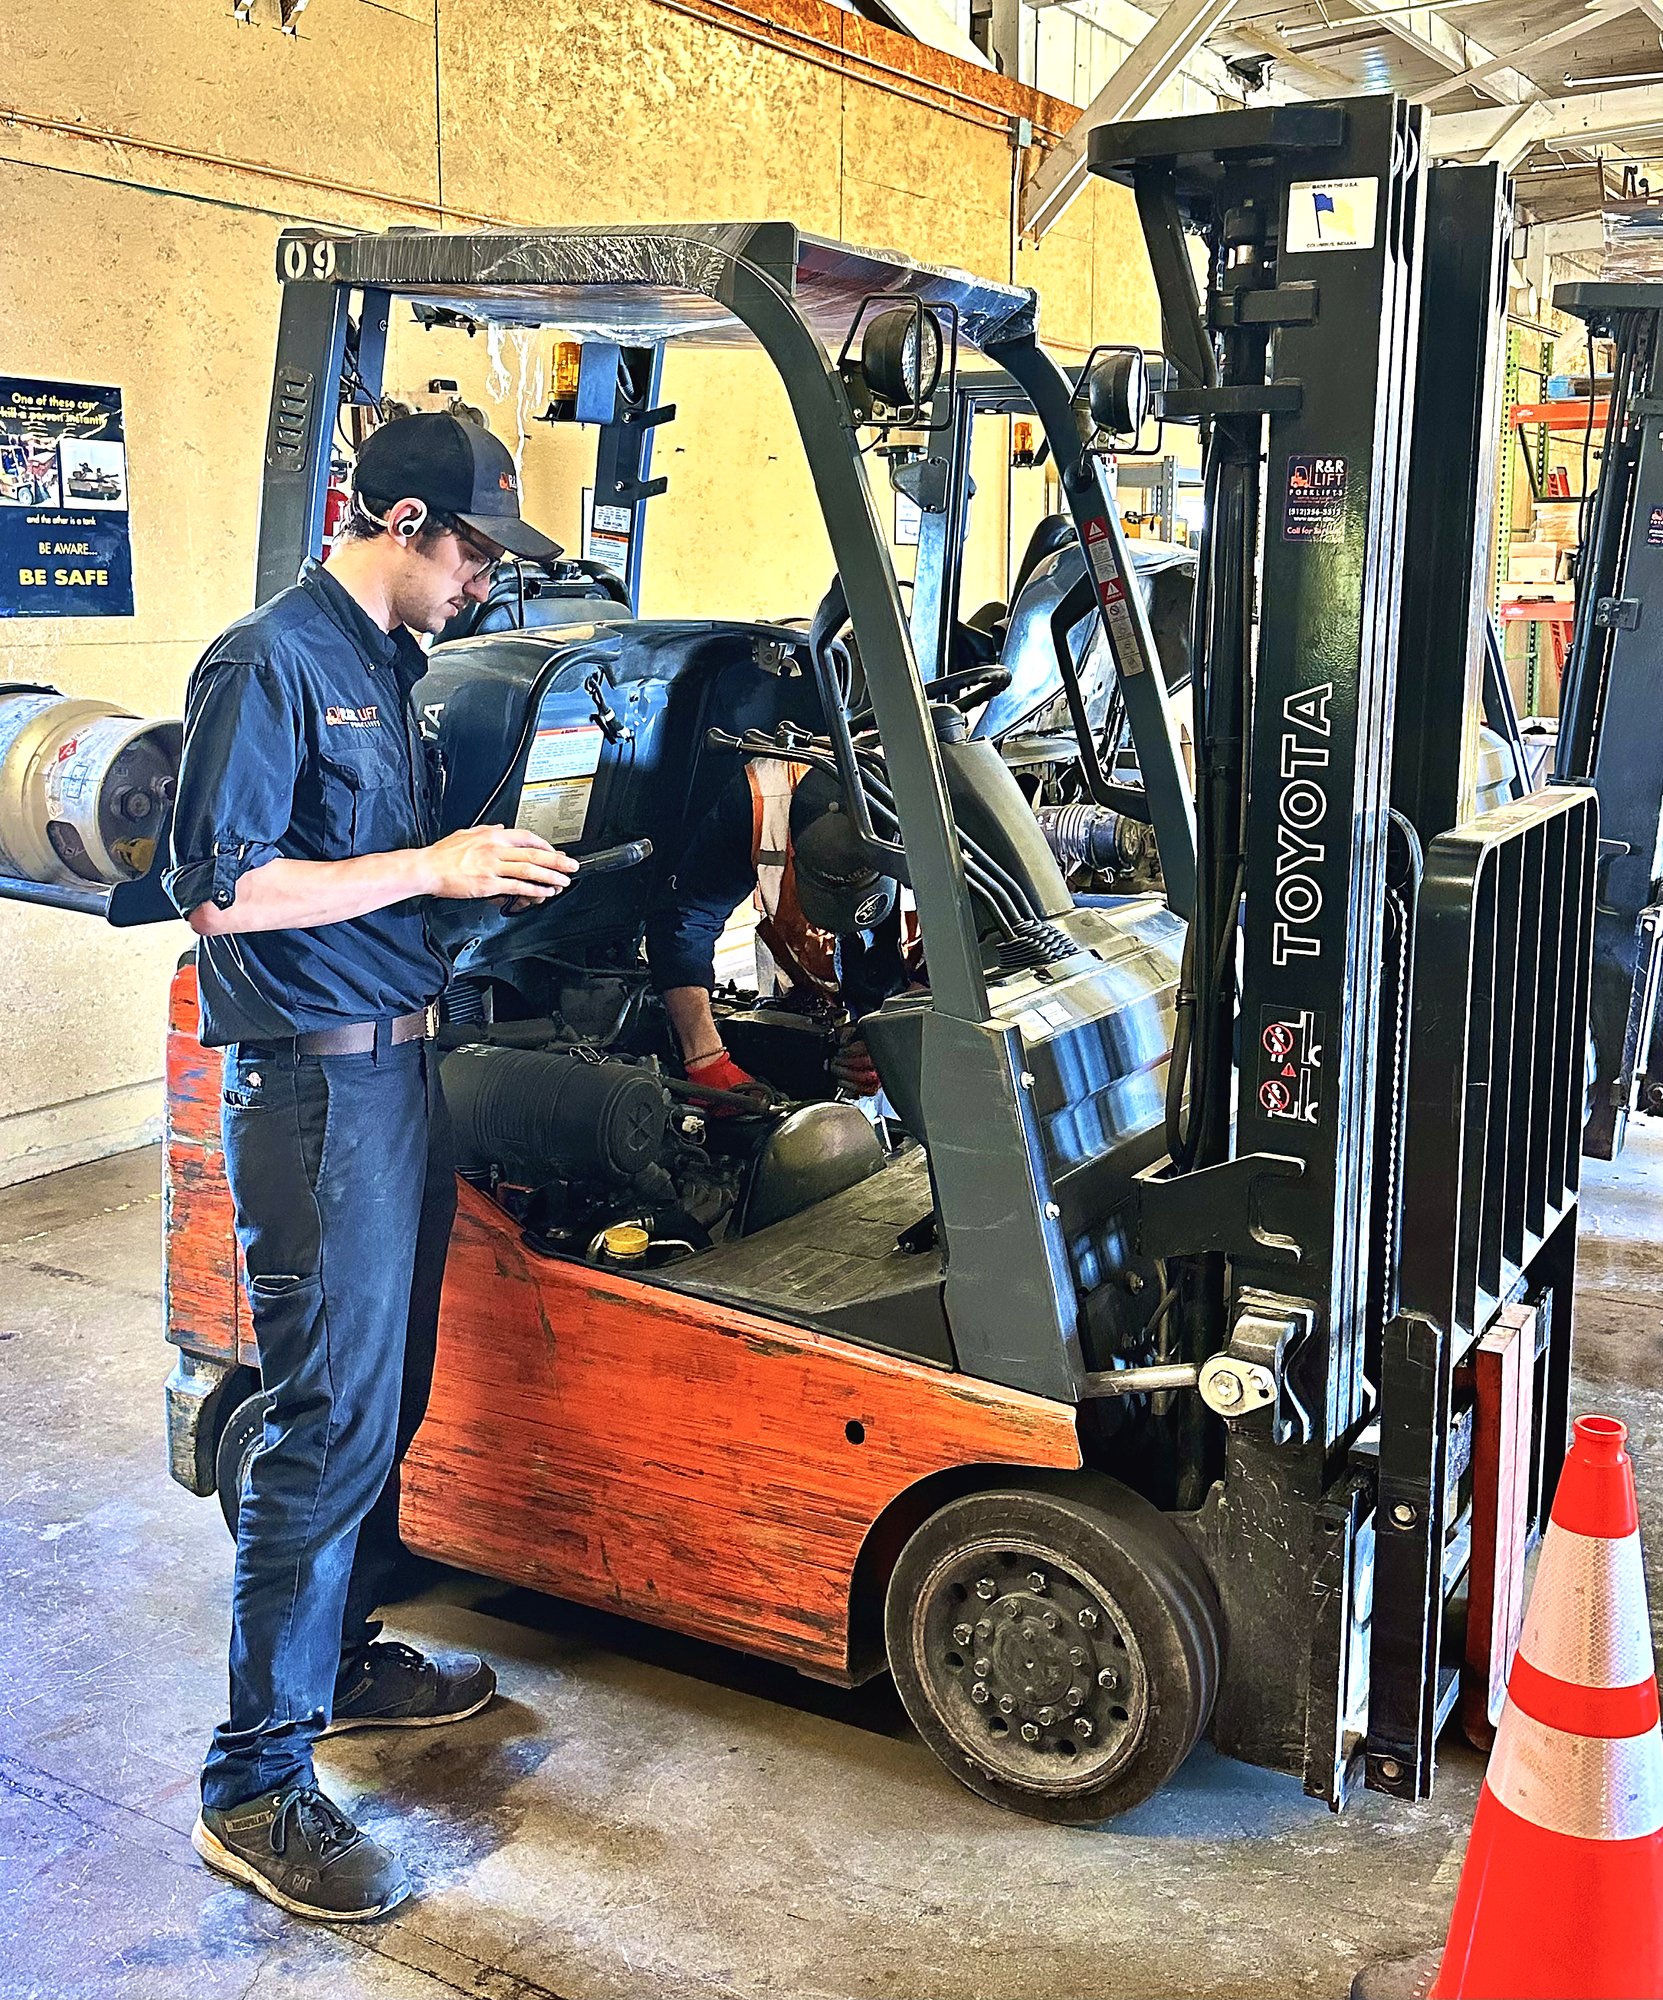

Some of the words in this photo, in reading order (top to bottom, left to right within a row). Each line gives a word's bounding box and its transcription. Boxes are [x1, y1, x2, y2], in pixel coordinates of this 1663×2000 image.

[284, 241, 336, 279] 09
[11, 392, 34, 405] One
[35, 394, 48, 406] of
[49, 395, 76, 409] these
[1315, 459, 1345, 473] R&R
[1314, 473, 1345, 486] LIFT
[1289, 488, 1343, 497] FORKLIFTS
[38, 541, 52, 555] BE
[19, 568, 47, 586] BE
[54, 568, 109, 586] SAFE
[1273, 682, 1333, 966] TOYOTA
